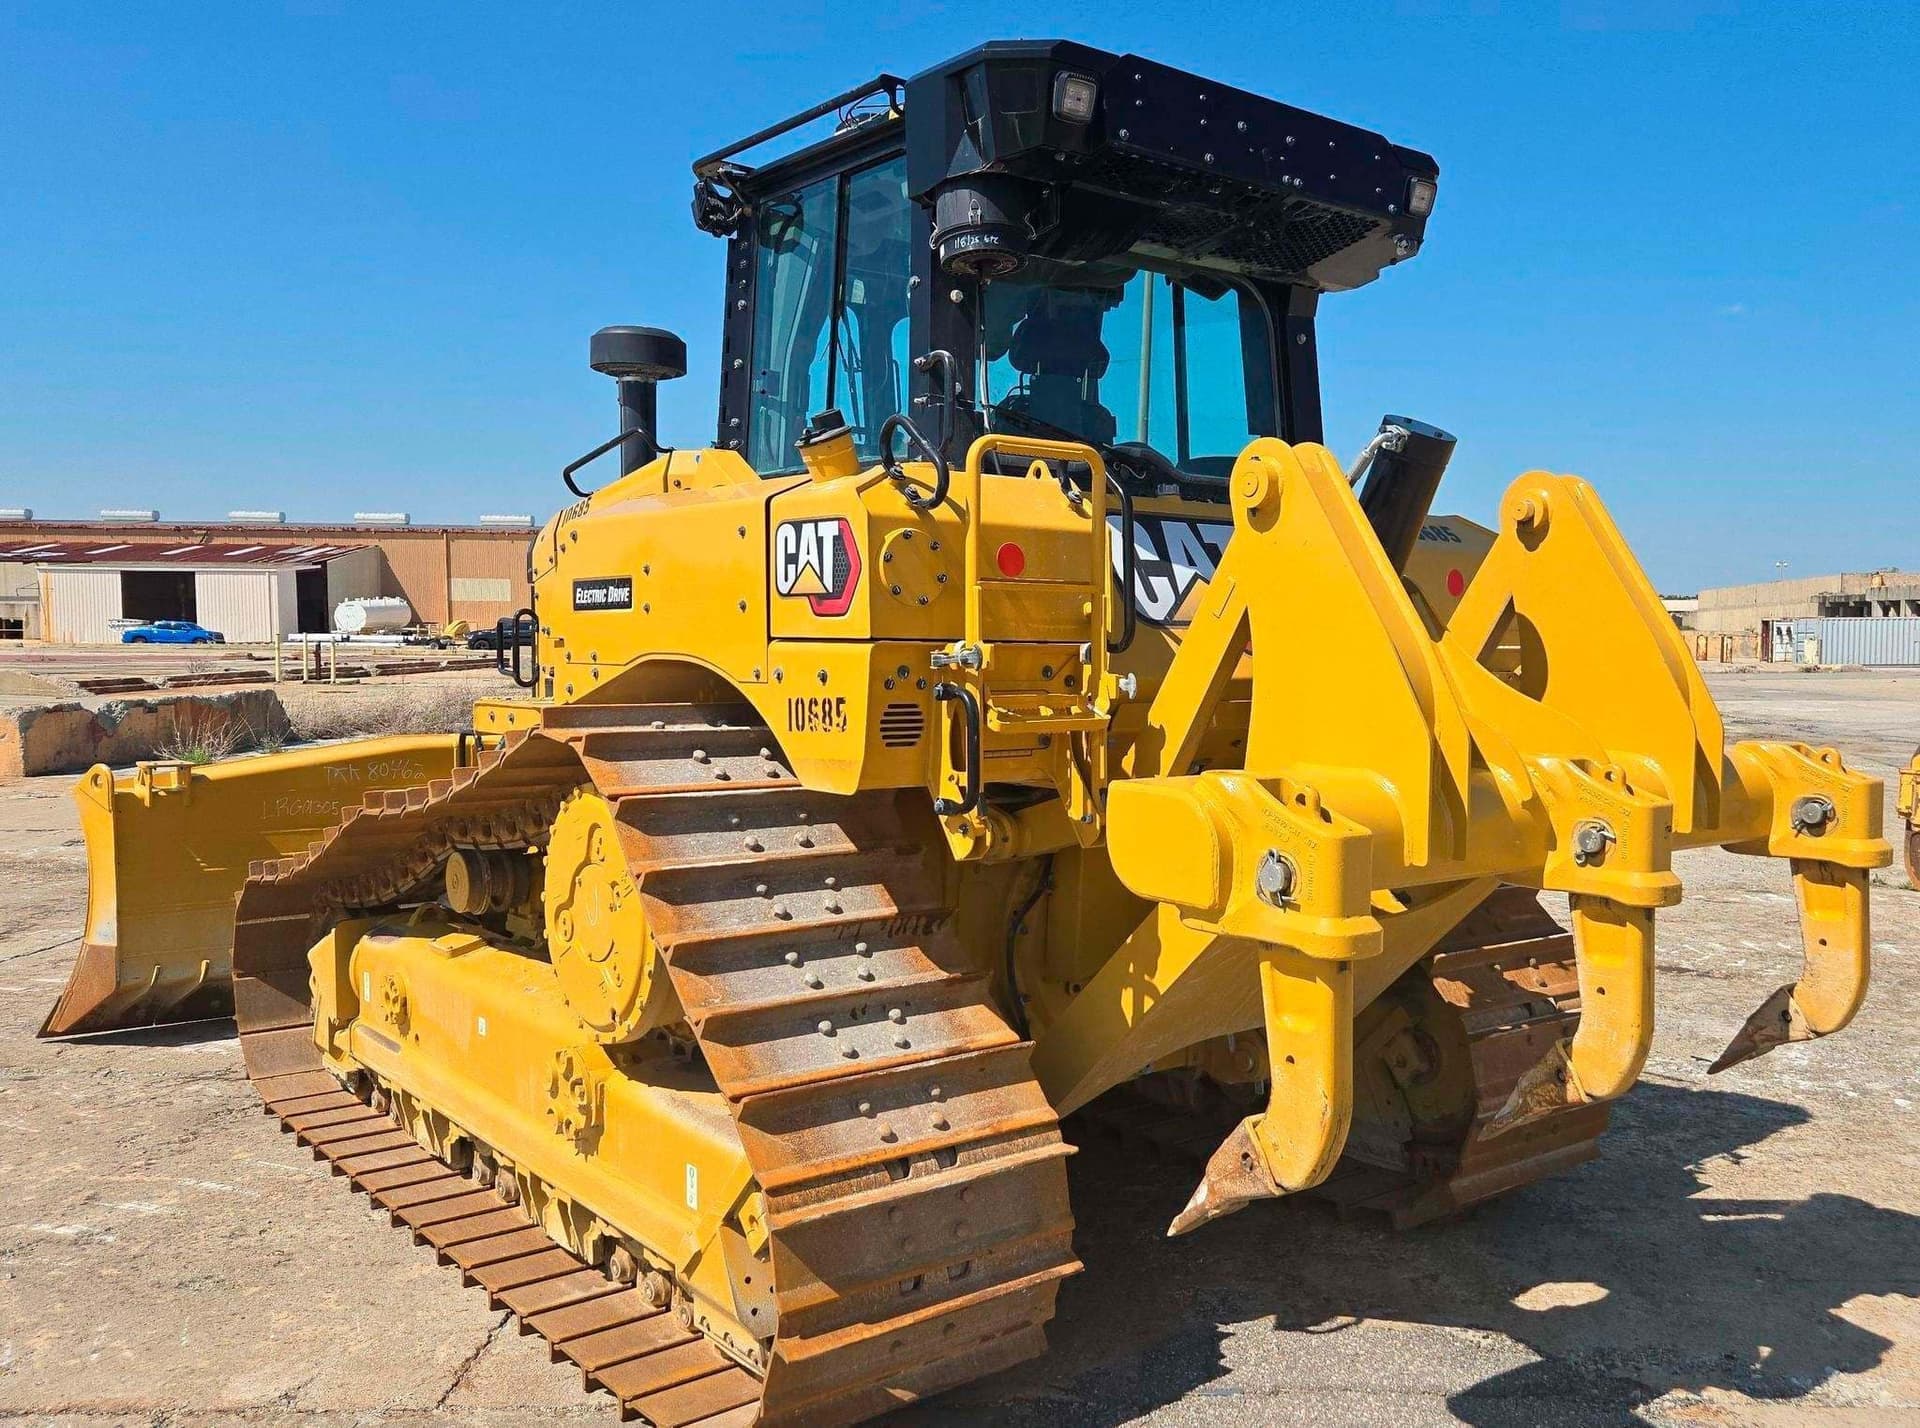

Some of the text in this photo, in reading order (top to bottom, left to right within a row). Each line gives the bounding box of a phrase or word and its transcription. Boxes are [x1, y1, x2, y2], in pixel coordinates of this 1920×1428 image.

[776, 520, 839, 595] CAT
[575, 585, 630, 604] ELECTRIC DRIVE
[787, 696, 848, 733] 10685
